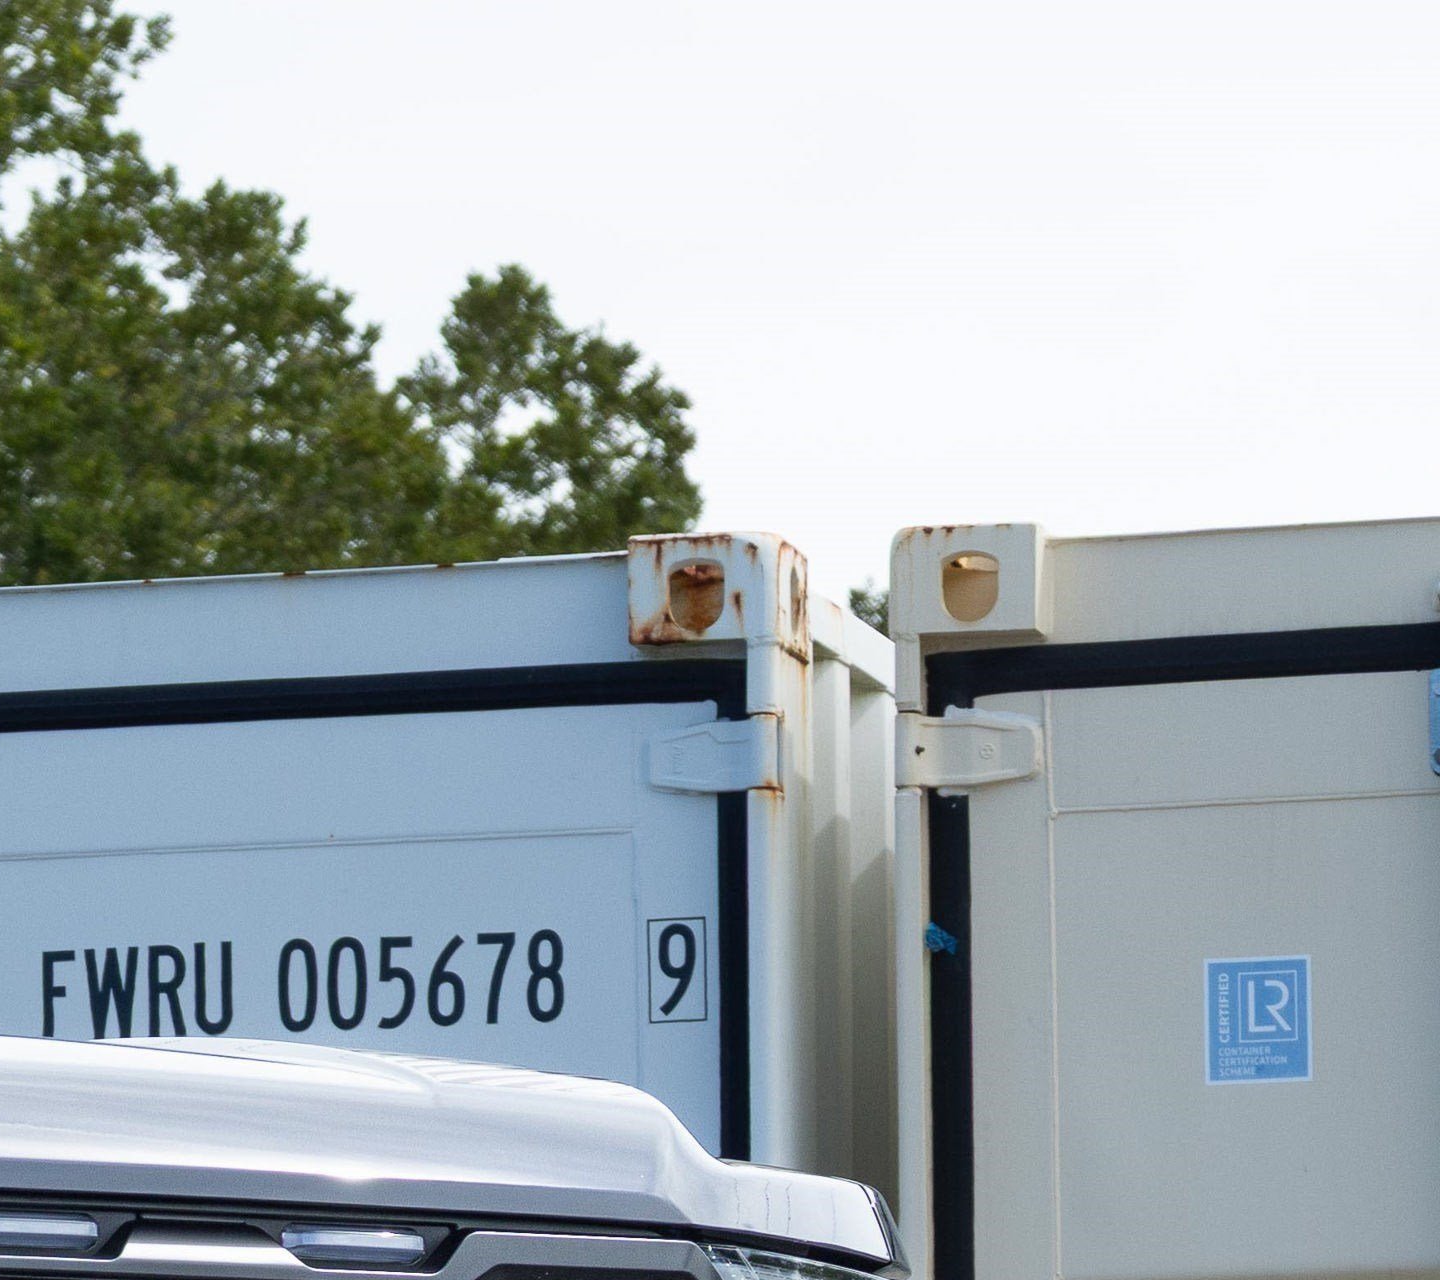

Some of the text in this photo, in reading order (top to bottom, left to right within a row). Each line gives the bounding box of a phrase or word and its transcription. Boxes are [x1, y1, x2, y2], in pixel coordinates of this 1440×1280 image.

[43, 924, 696, 1037] FWRU 005678 9
[1218, 972, 1230, 1044] CERTIFIED
[1248, 979, 1292, 1033] LR
[1218, 1046, 1271, 1056] CONTAINER
[1218, 1055, 1288, 1067] CERTIFICATION
[1219, 1066, 1256, 1077] SCHEME
